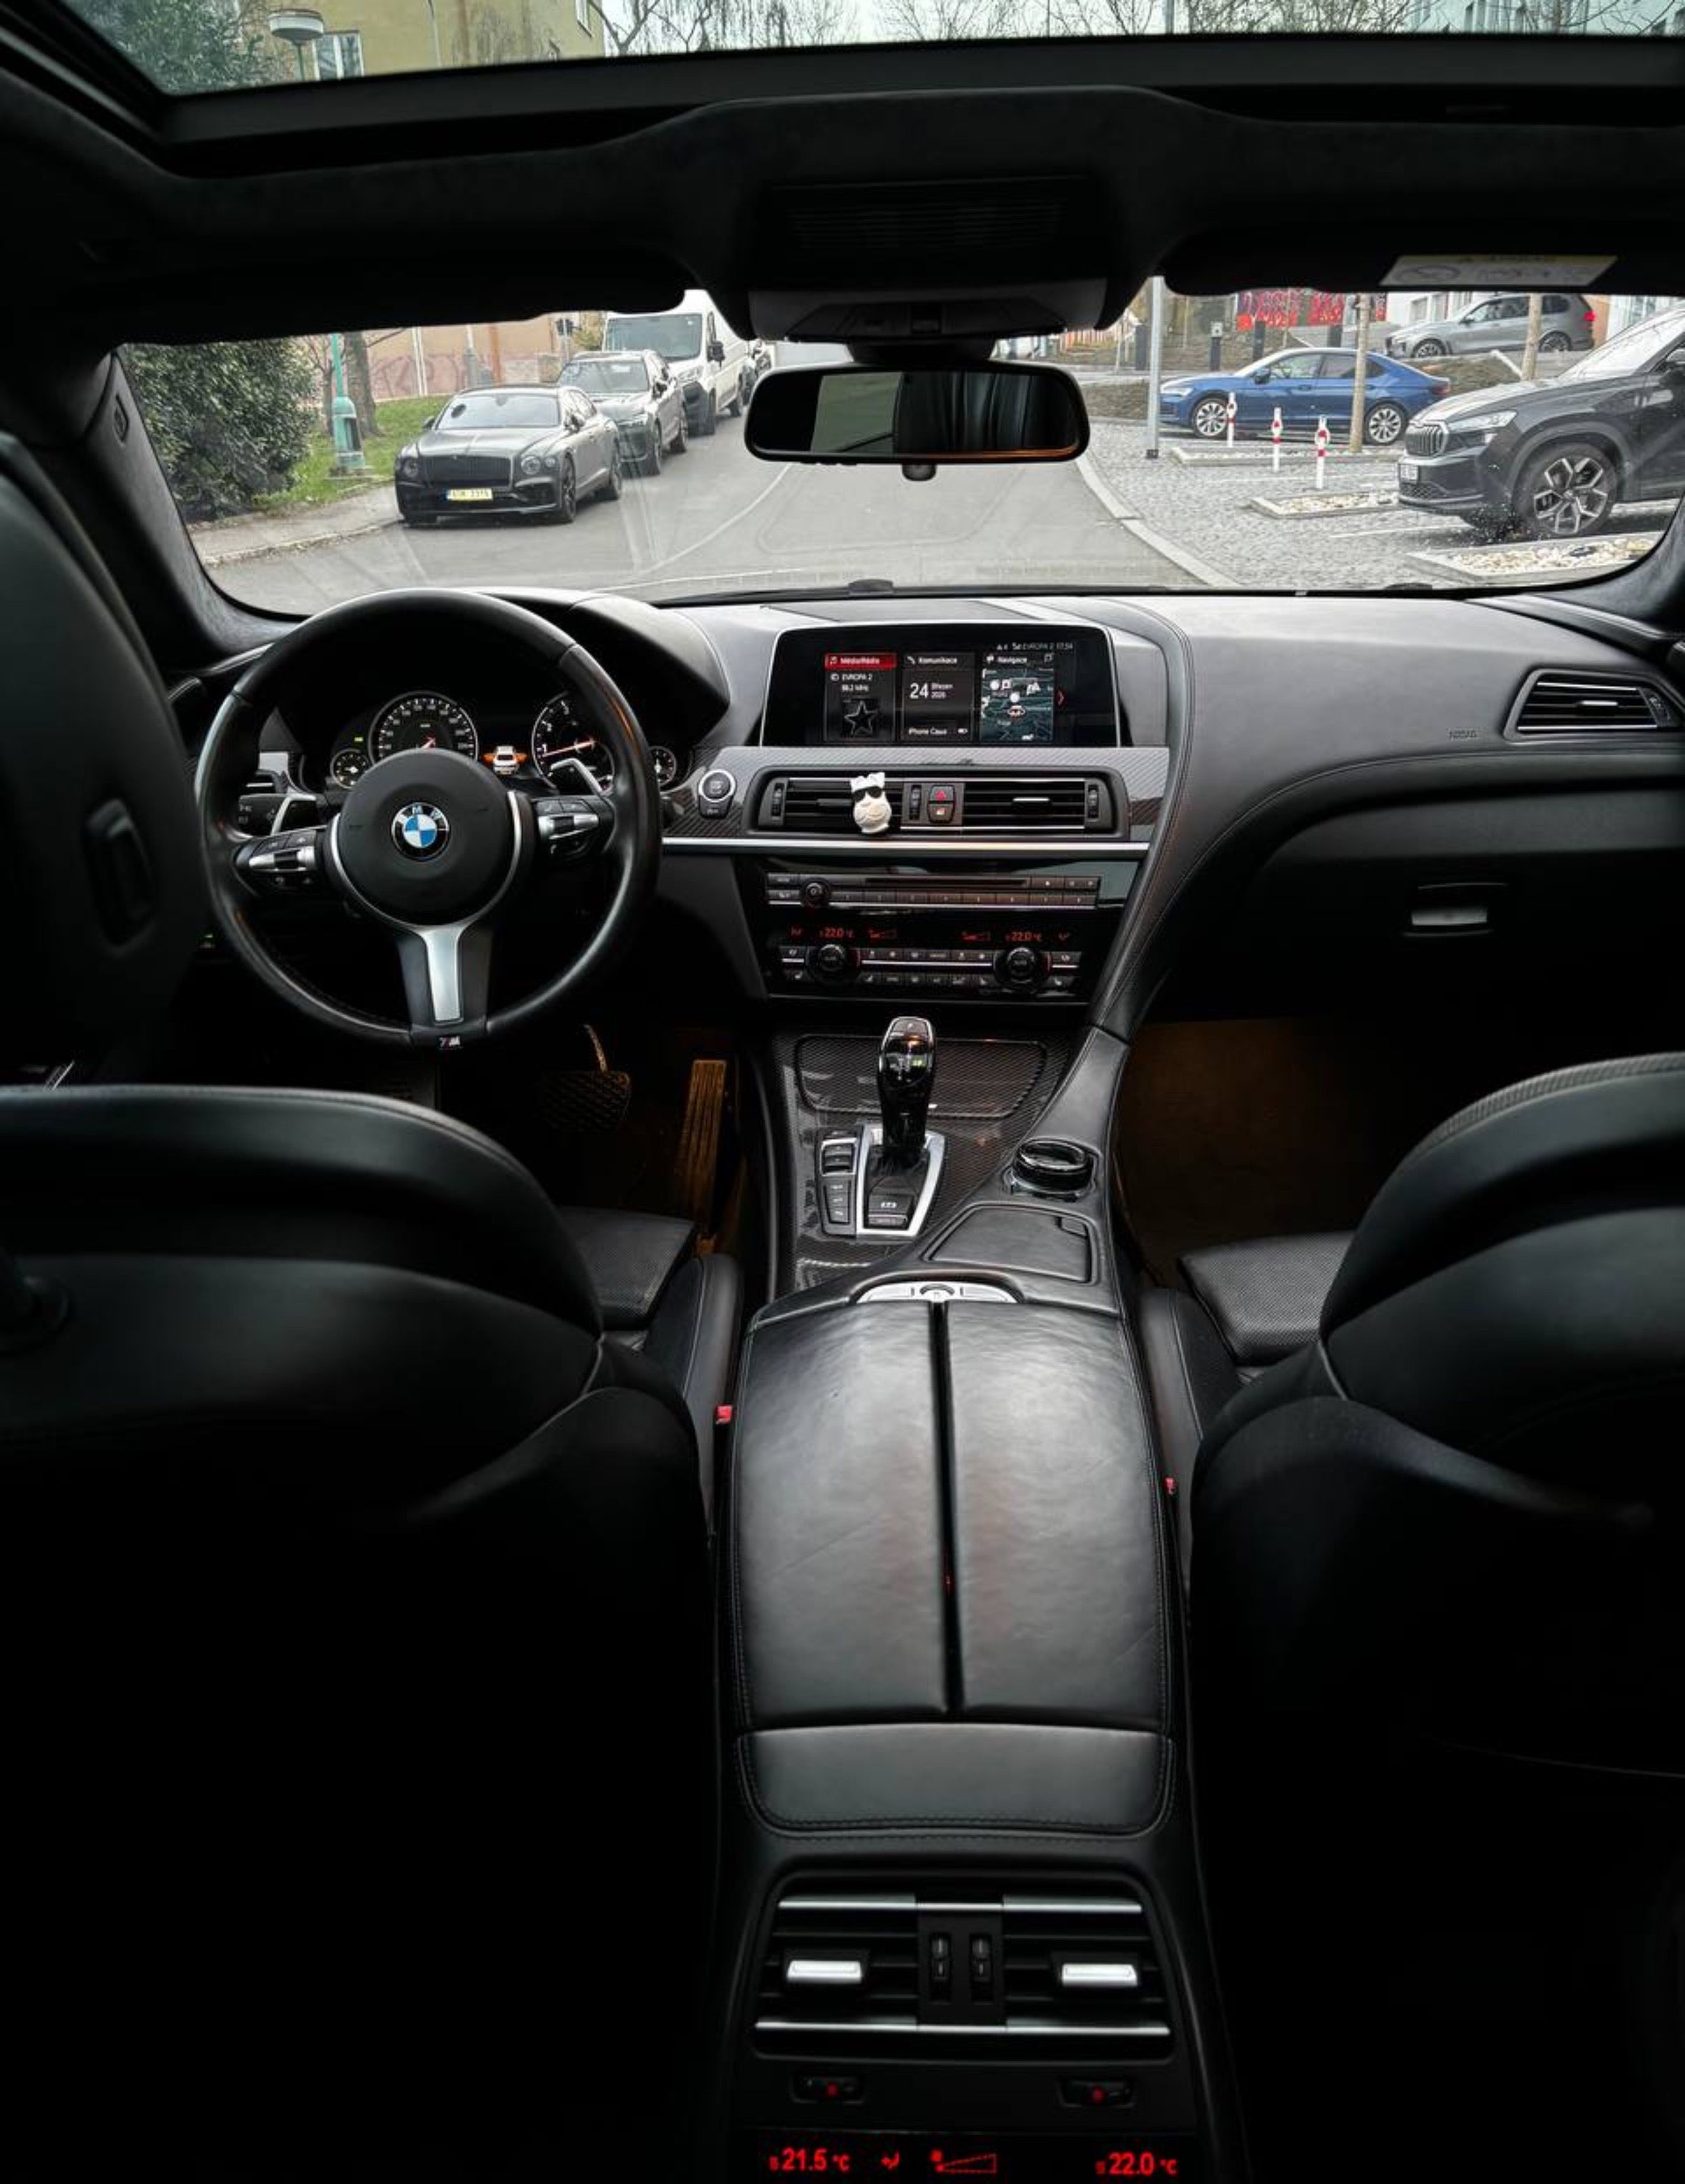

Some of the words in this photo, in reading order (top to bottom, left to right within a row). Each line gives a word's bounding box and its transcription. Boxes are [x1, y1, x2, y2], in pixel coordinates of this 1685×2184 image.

[911, 683, 929, 698] 24
[781, 2147, 828, 2172] 21.5
[1108, 2152, 1154, 2175] 22.0
